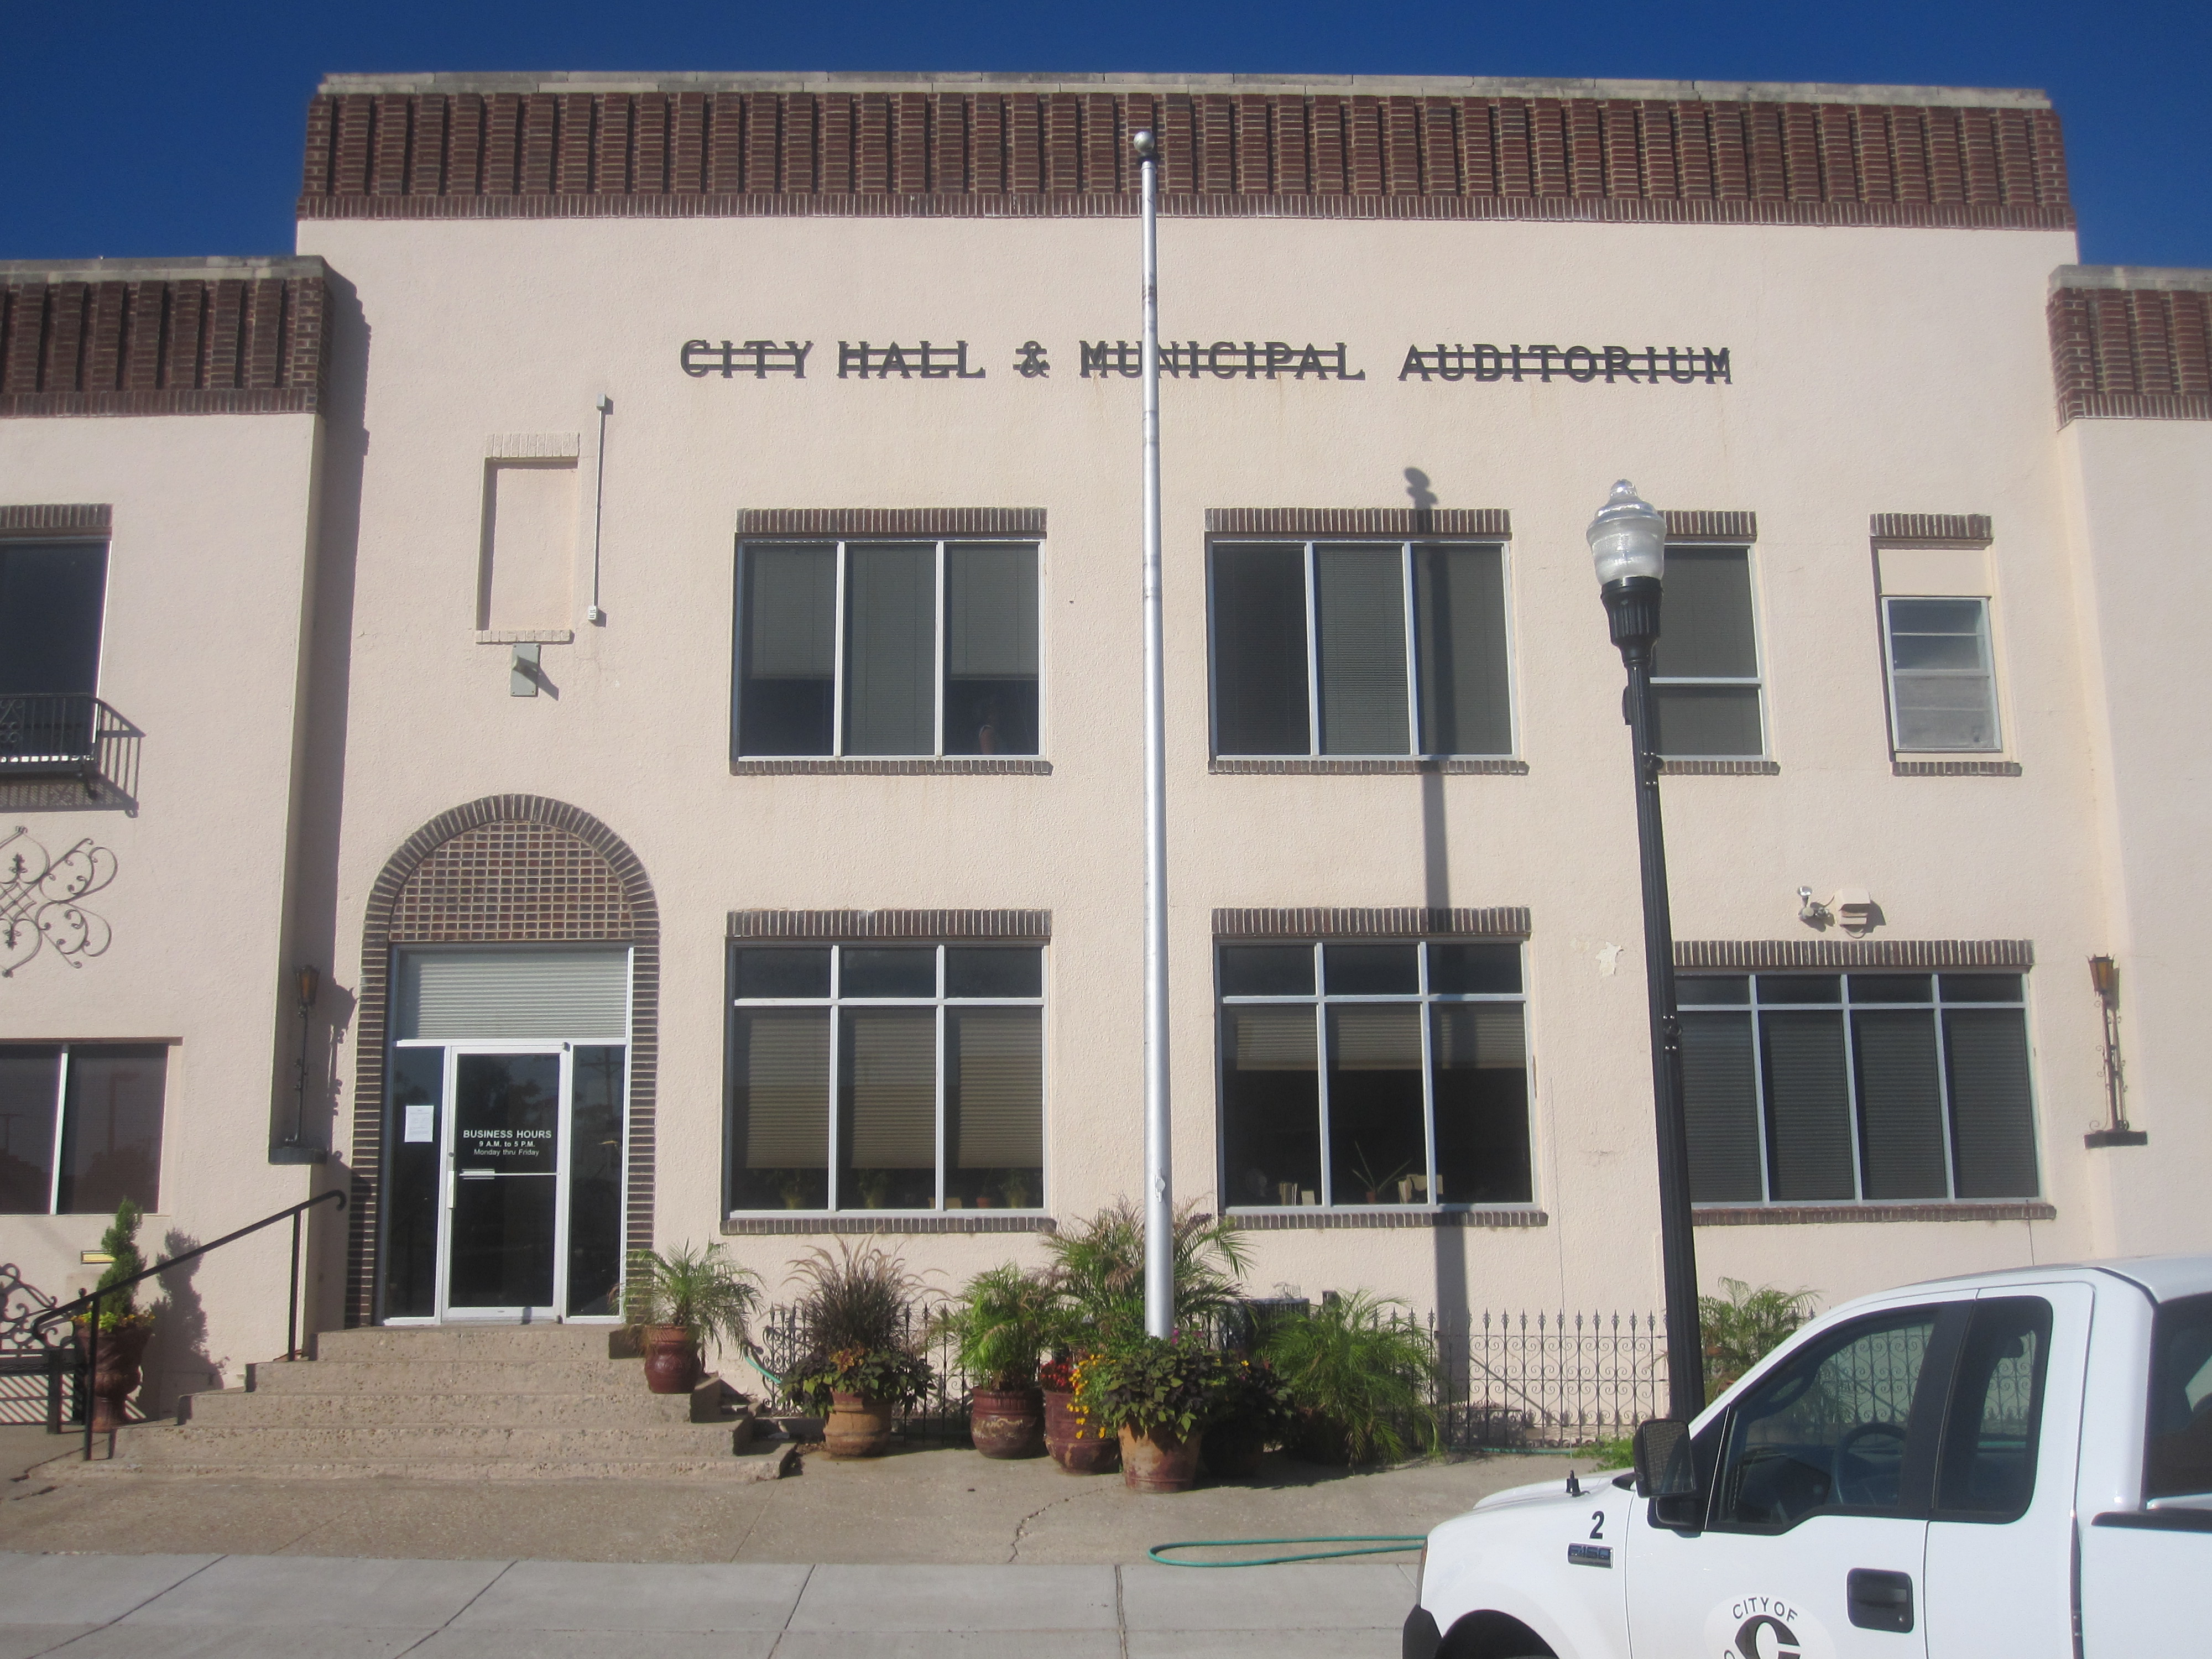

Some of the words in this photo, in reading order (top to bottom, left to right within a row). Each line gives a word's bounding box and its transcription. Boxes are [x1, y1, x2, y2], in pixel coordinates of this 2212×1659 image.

[680, 340, 812, 379] CITY
[837, 340, 986, 379] HALL
[1013, 340, 1050, 378] &
[1079, 340, 1365, 380] MUNICIPAL
[1397, 343, 1733, 385] AUDITORIUM
[463, 1130, 513, 1138] BUSINESS
[517, 1130, 552, 1139] HOURS
[1589, 1510, 1604, 1539] 2
[1733, 1597, 1769, 1619] CITY
[1773, 1601, 1798, 1622] OF
